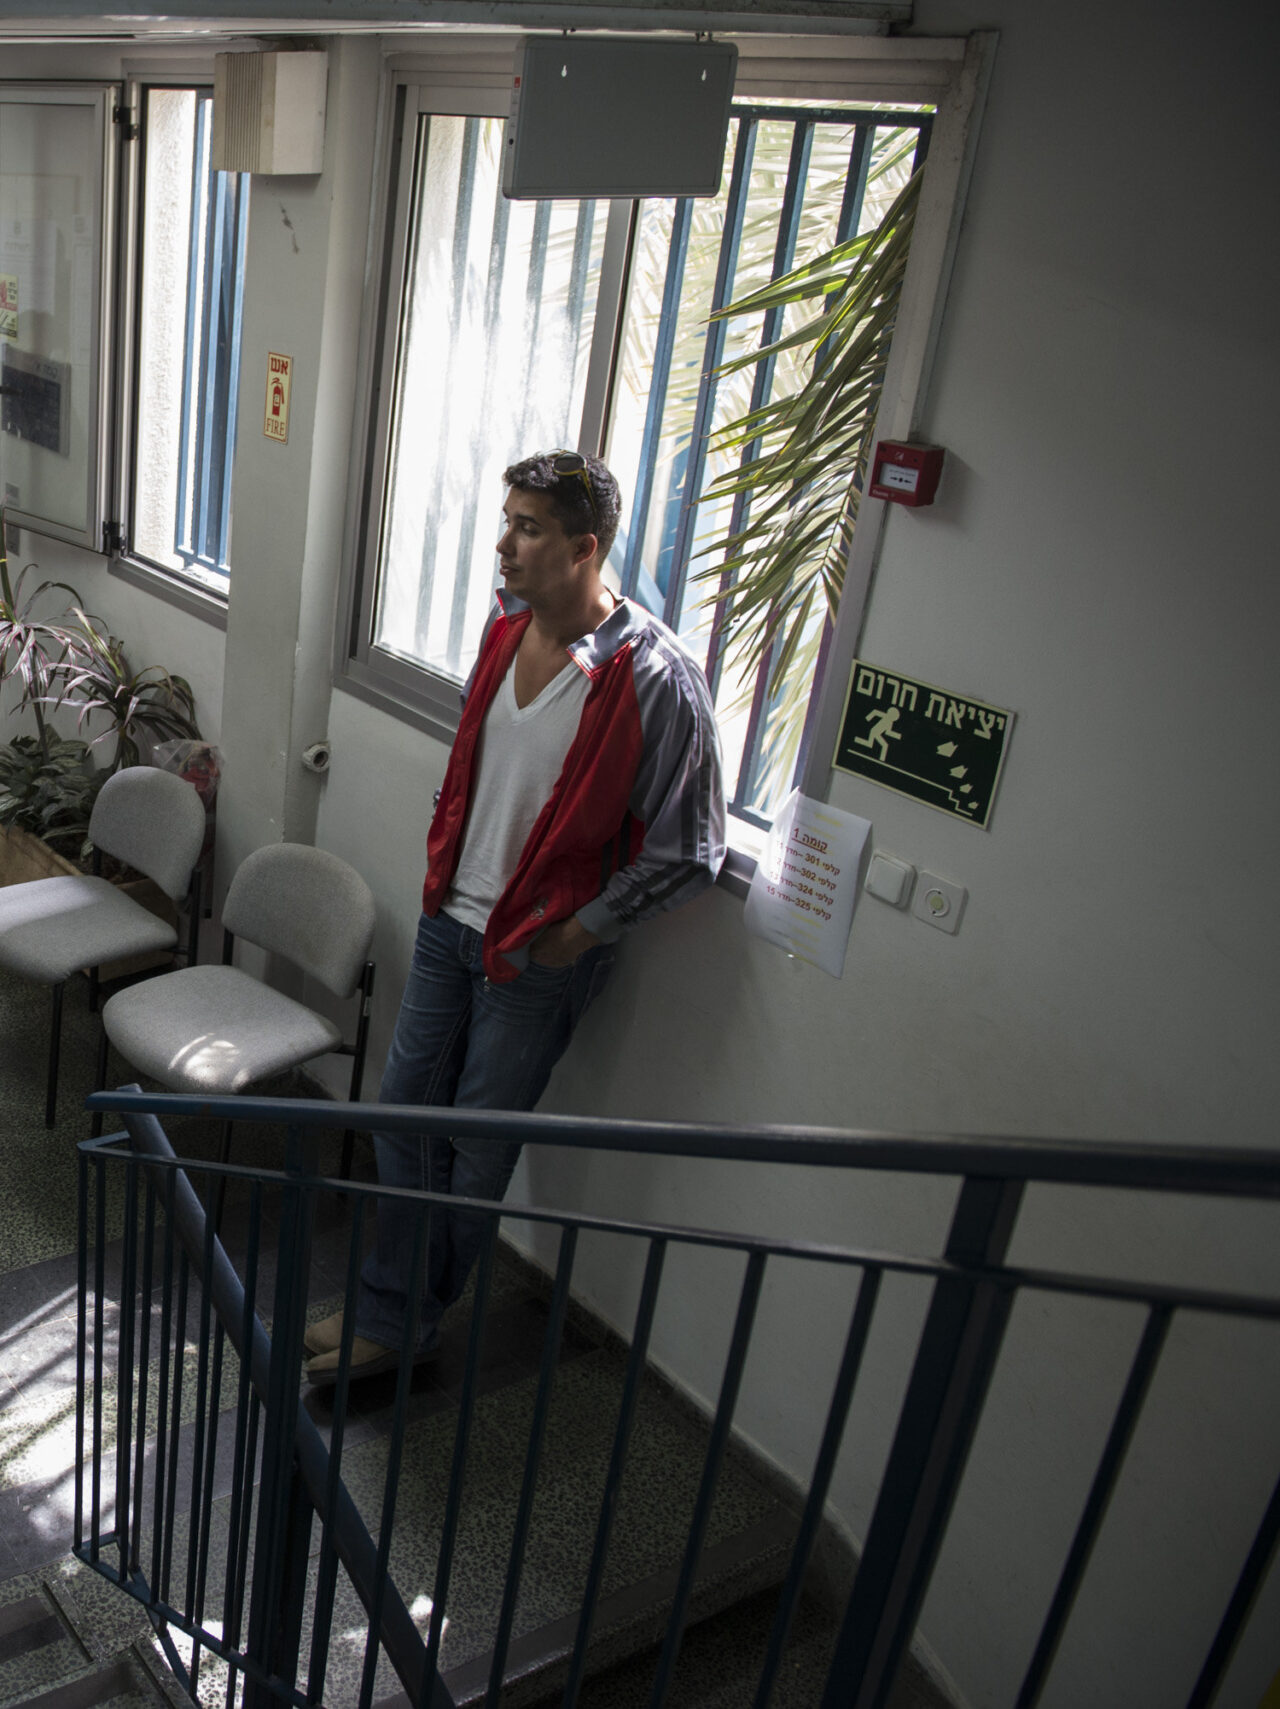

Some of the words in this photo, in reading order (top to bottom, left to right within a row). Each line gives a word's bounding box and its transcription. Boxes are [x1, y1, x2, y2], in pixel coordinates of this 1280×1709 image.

[270, 357, 289, 376] אש
[266, 418, 286, 437] FIRE
[855, 668, 918, 712] חרום
[924, 692, 1006, 741] יציאת
[793, 827, 800, 838] 1
[802, 833, 828, 851] קומה
[805, 853, 820, 867] 301
[822, 862, 841, 876] קלפי
[766, 884, 776, 896] 15
[818, 877, 837, 891] קלפי
[815, 891, 834, 906] קלפי
[812, 905, 832, 921] קלפי
